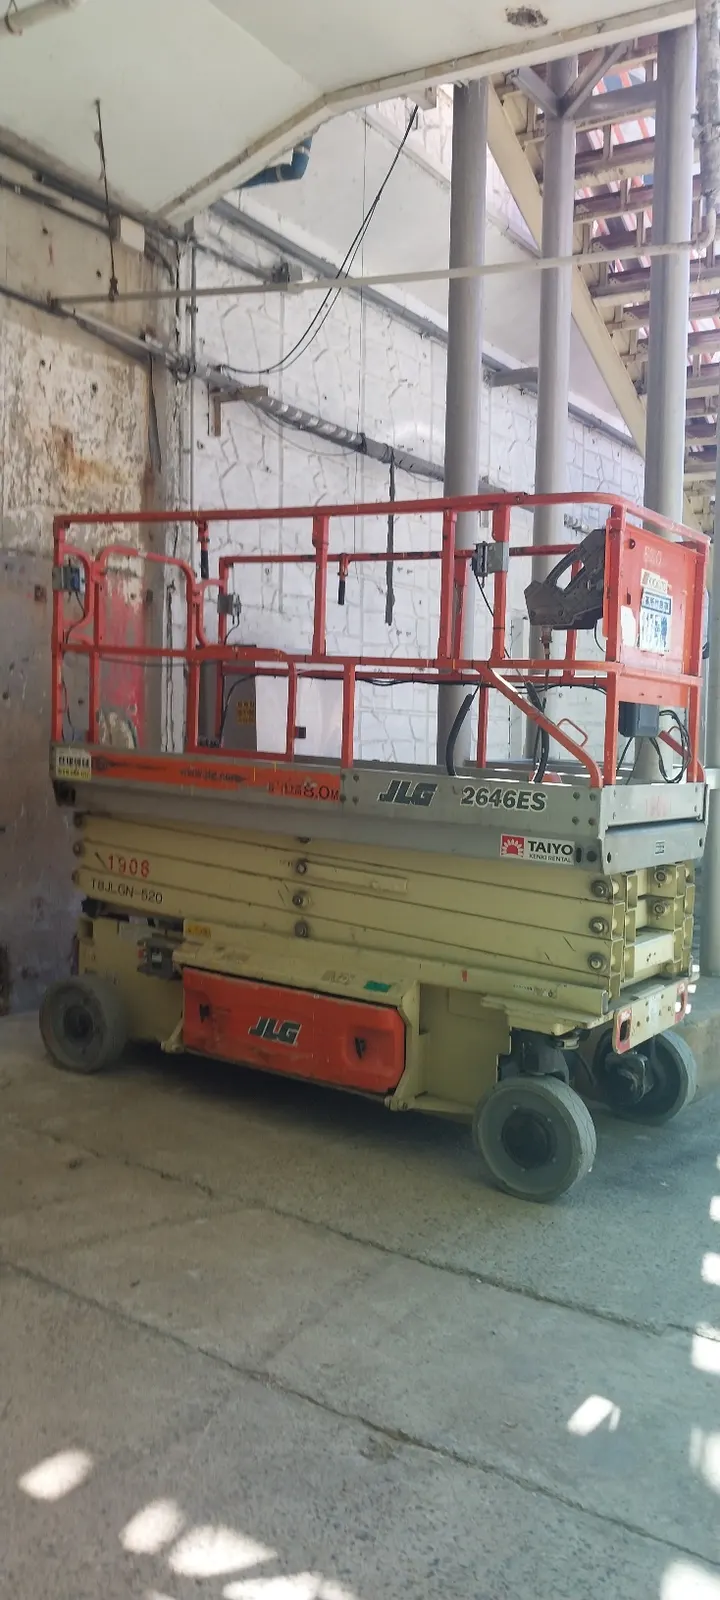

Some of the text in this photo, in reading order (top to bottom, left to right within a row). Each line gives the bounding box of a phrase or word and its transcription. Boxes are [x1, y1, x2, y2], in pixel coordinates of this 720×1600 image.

[377, 780, 547, 812] JLG 2646ES
[528, 841, 573, 855] TAIYO
[529, 853, 571, 863] KENKI RENTAL
[248, 1016, 302, 1045] JLG
